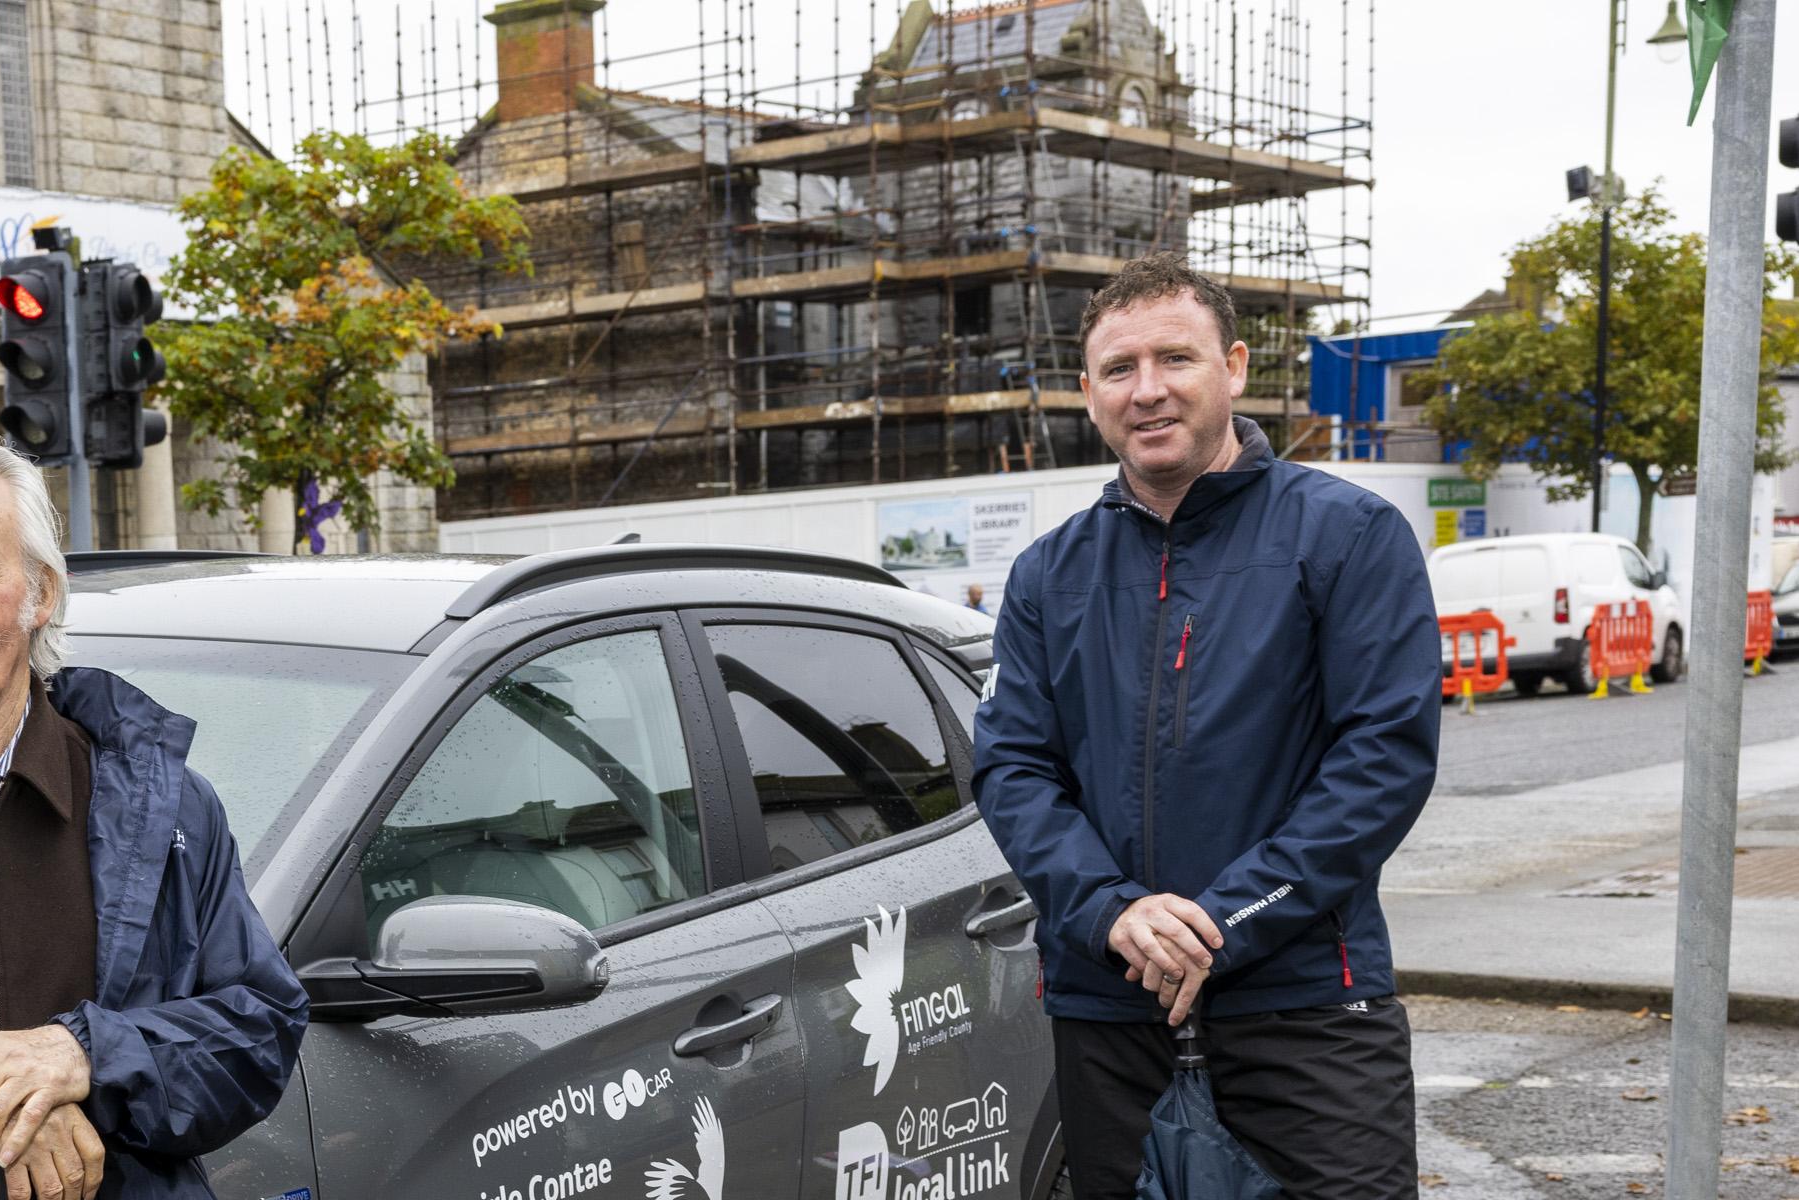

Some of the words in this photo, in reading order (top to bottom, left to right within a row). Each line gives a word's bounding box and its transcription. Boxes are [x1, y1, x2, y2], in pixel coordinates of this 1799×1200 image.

[1267, 883, 1294, 904] HELLY
[1225, 899, 1268, 927] HANSEN
[908, 1042, 921, 1056] Age
[922, 1029, 947, 1048] Friendly
[949, 1021, 972, 1037] County
[473, 1089, 567, 1168] powered
[567, 1084, 595, 1116] by
[960, 1141, 1009, 1196] link
